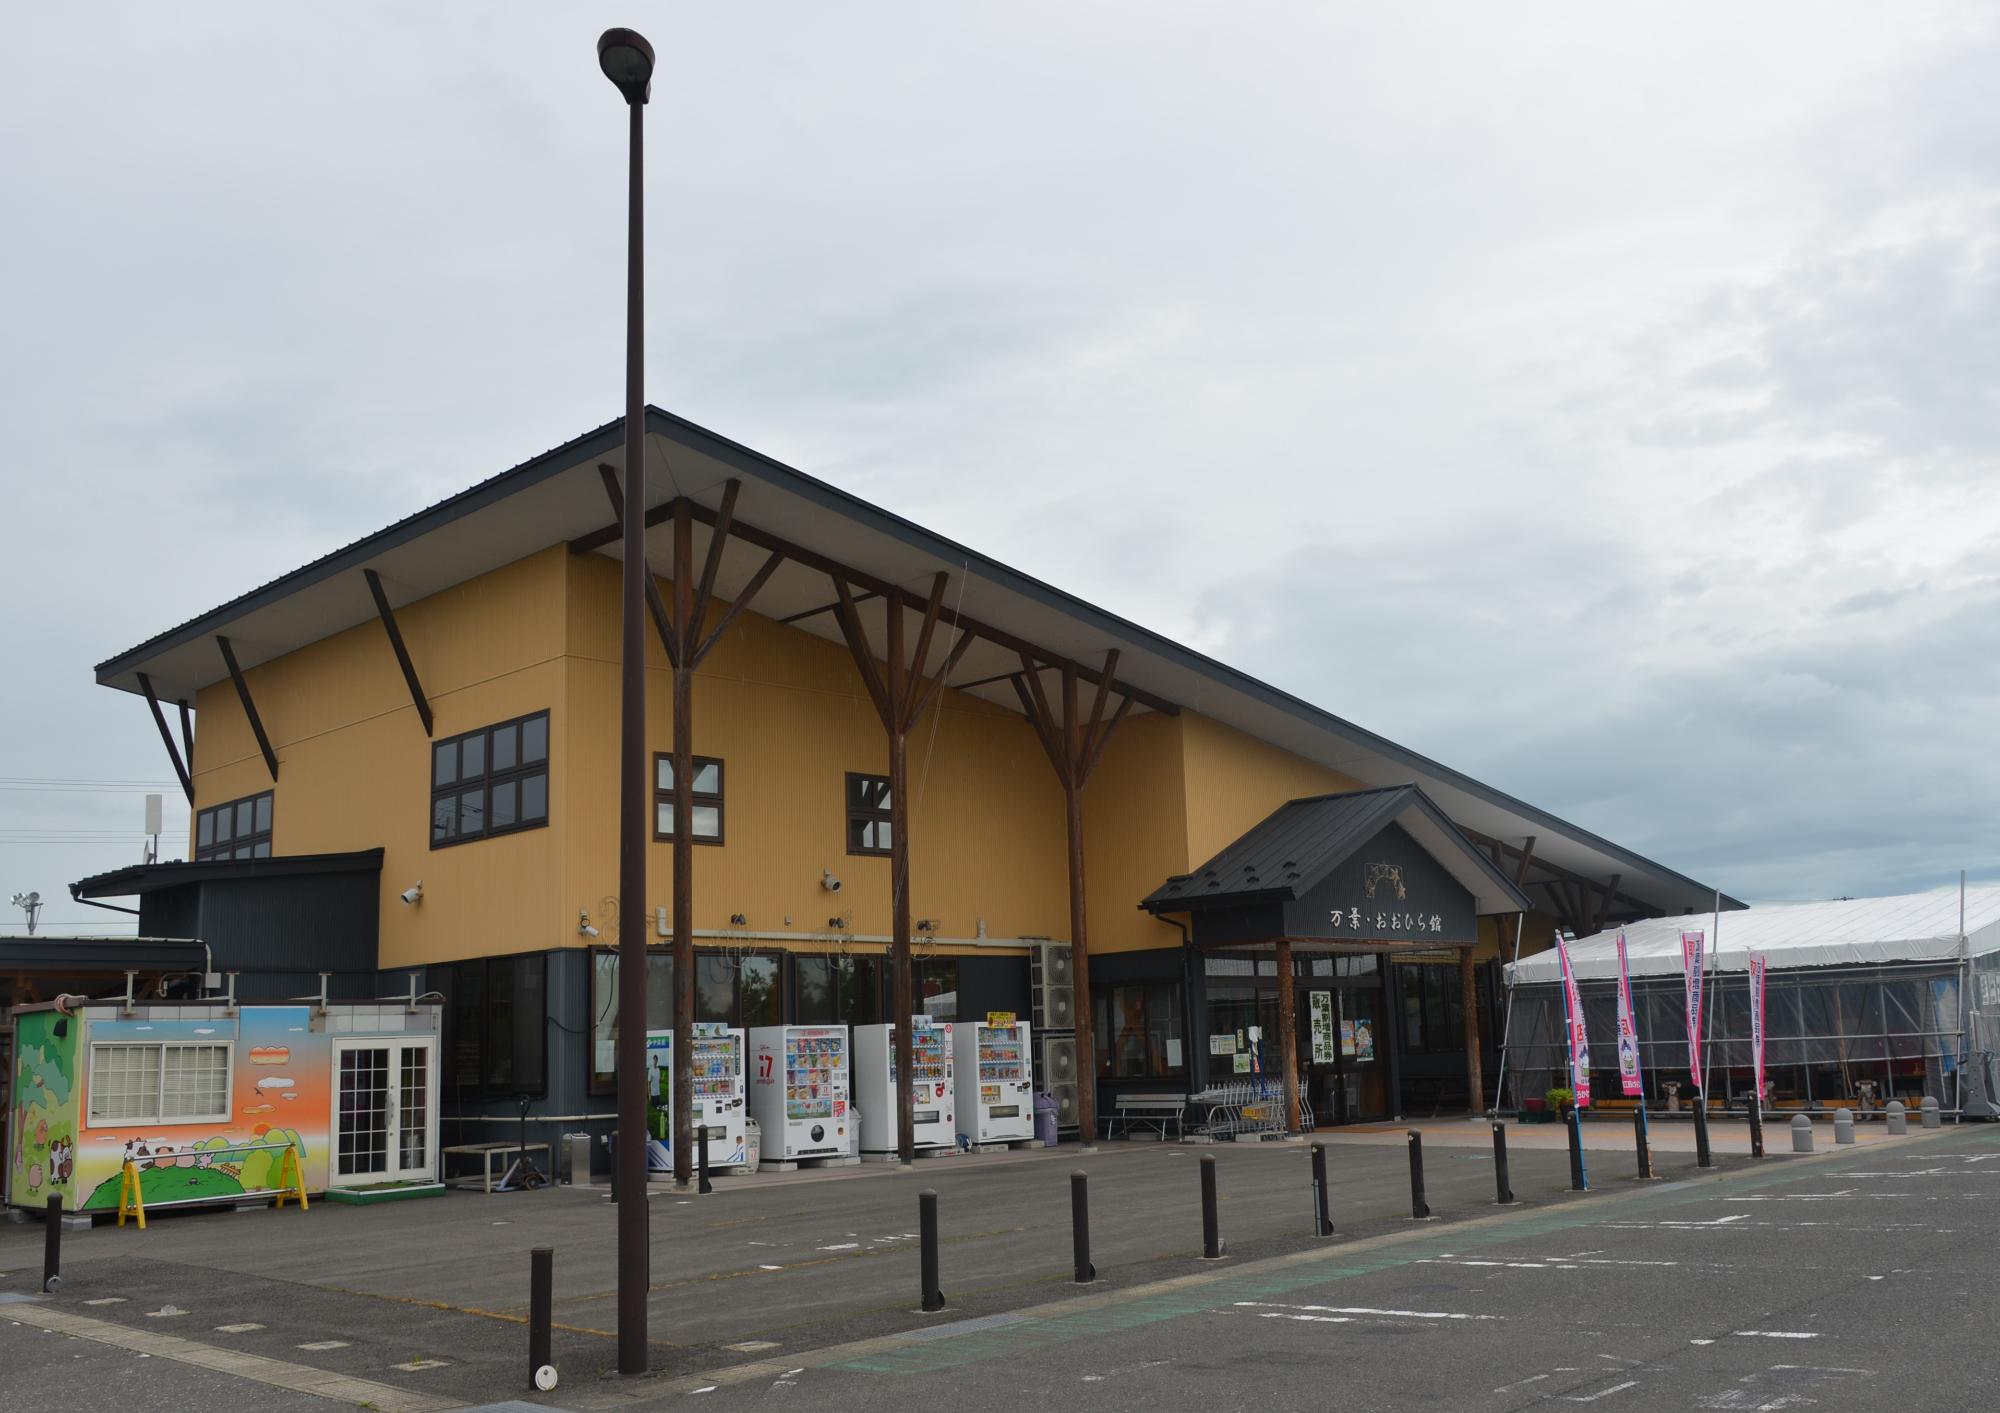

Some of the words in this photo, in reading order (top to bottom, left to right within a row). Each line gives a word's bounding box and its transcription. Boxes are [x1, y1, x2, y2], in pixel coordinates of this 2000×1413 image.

[1311, 993, 1323, 1060] 販売所
[1320, 994, 1333, 1061] 万葉割増商品券
